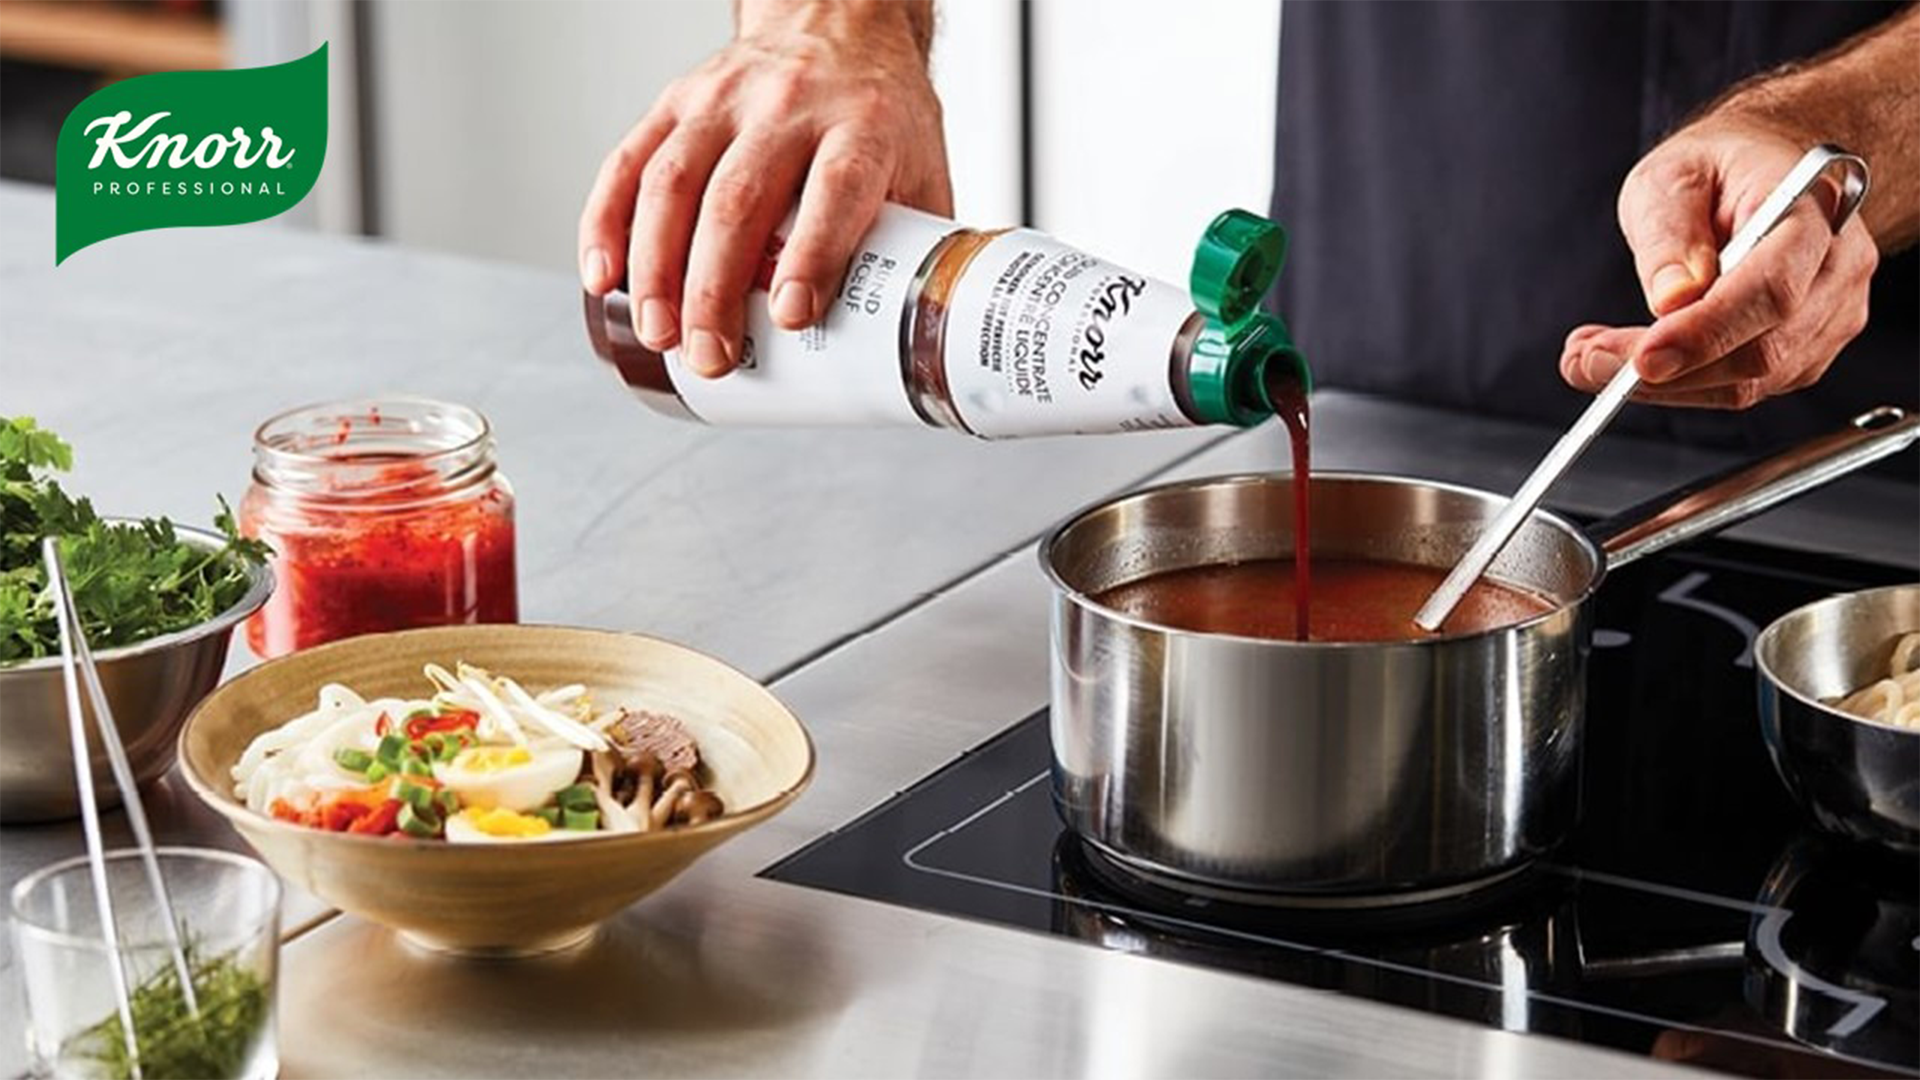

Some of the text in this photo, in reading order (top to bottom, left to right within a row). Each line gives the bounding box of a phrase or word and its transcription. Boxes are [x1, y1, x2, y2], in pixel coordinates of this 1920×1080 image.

[864, 258, 897, 315] RUND
[979, 302, 997, 367] PERFECTION
[1014, 328, 1033, 396] LIQUIDE
[1032, 280, 1067, 404] CONCENTRATE
[1078, 275, 1146, 391] Knorr
